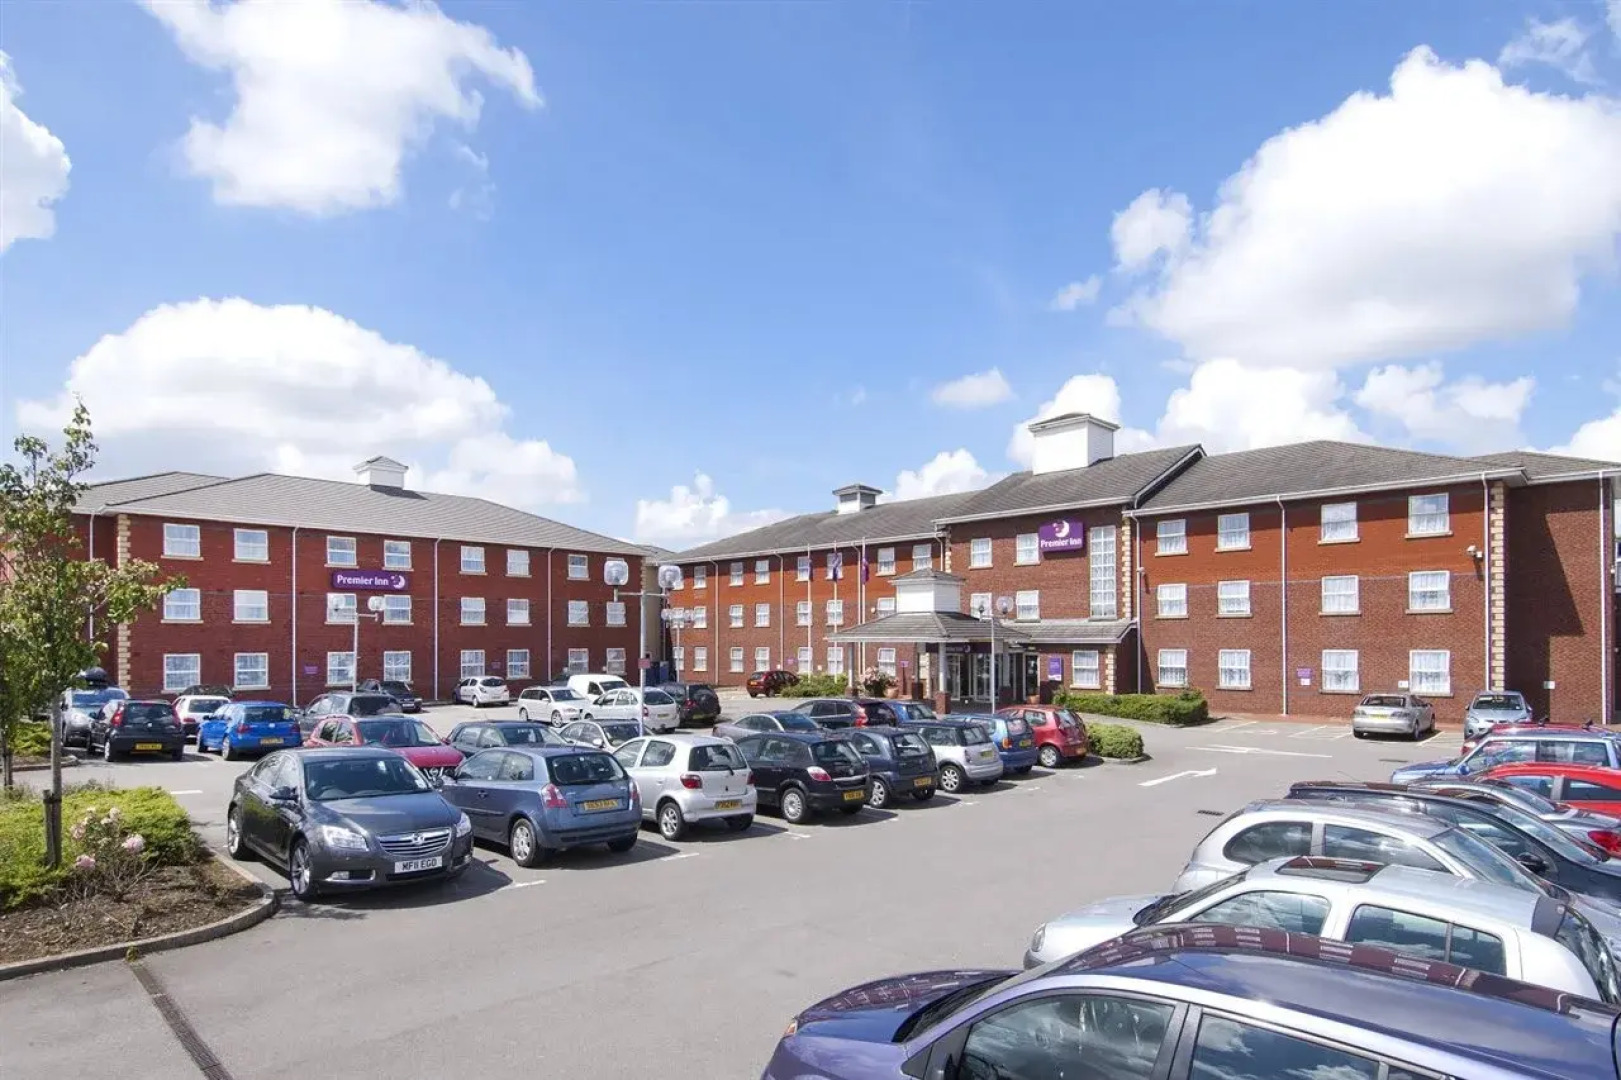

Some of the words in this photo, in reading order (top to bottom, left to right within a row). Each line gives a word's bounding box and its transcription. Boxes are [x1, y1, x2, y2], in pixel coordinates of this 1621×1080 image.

[1040, 539, 1069, 548] Premier
[1070, 537, 1082, 546] Inn
[336, 574, 373, 585] Premier
[374, 576, 389, 586] Inn
